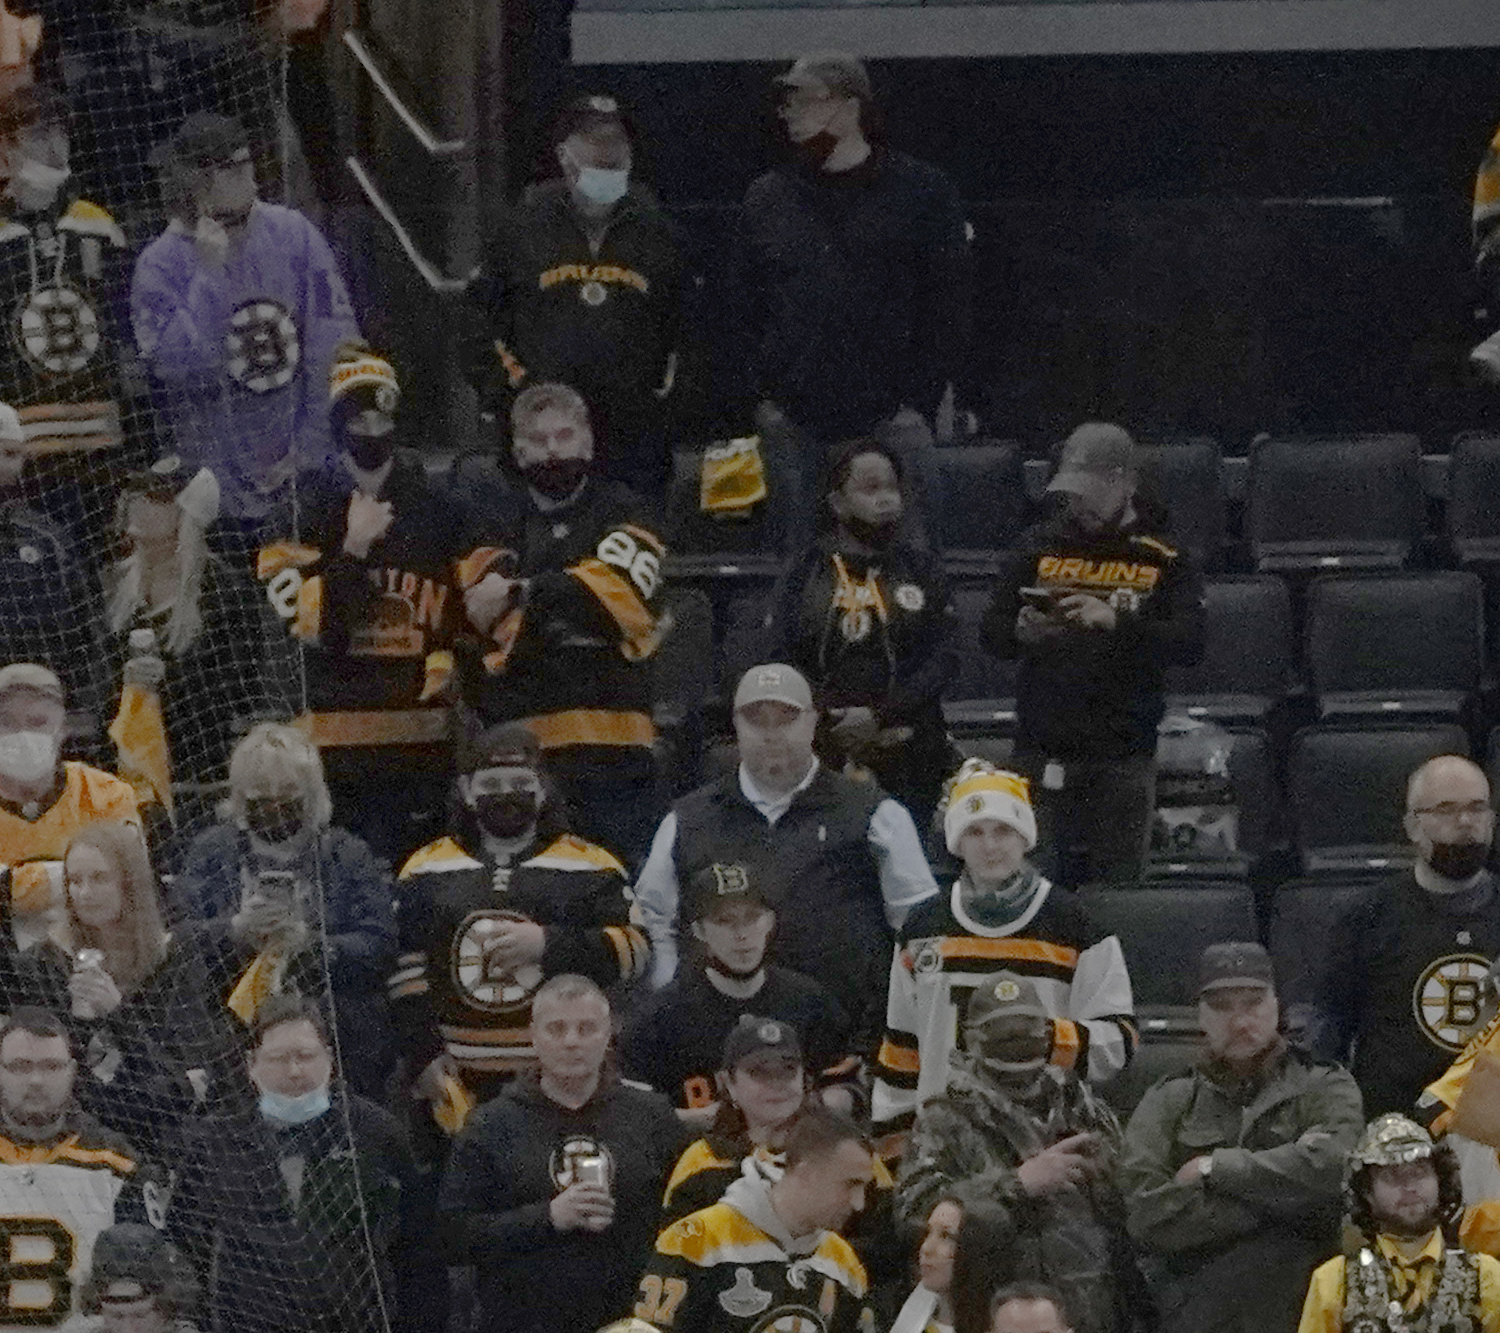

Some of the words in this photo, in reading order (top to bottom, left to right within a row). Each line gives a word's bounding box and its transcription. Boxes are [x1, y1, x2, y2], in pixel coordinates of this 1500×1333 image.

[1038, 555, 1160, 592] BRUINS
[1444, 979, 1481, 1024] B
[637, 1275, 688, 1325] 37
